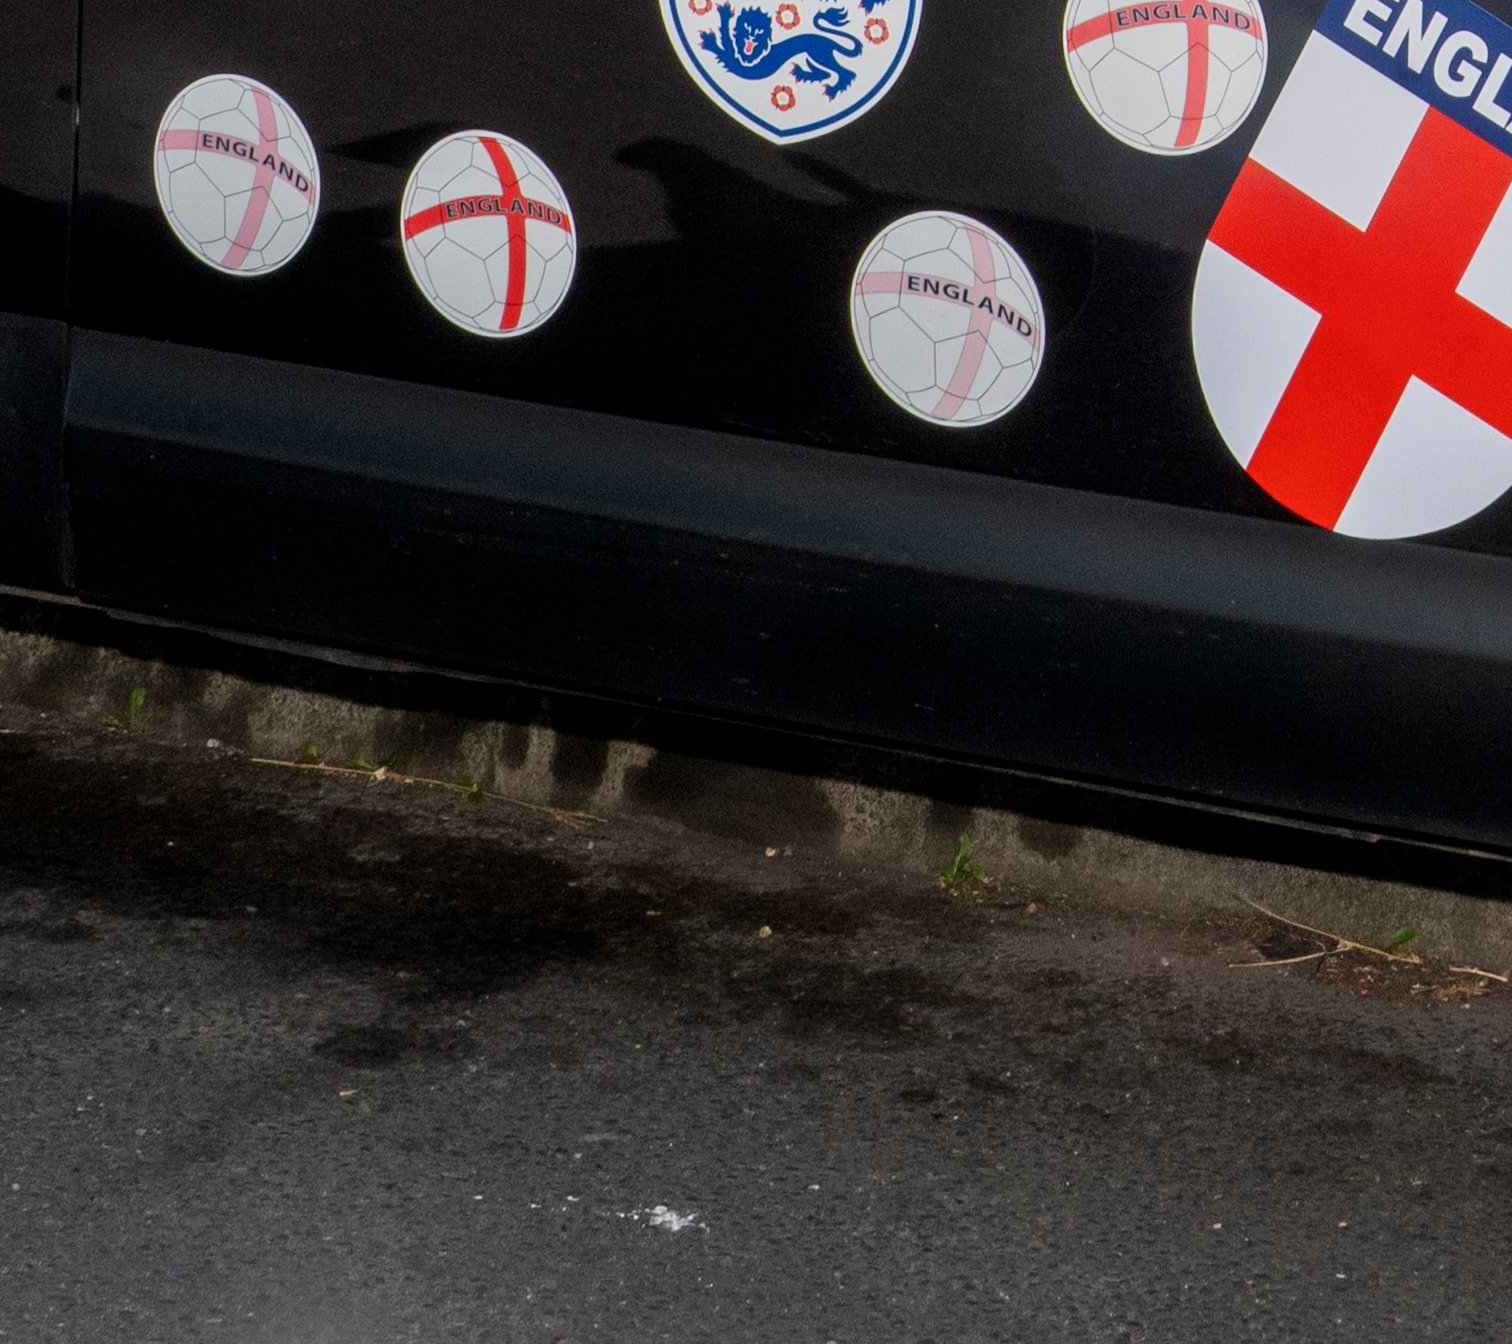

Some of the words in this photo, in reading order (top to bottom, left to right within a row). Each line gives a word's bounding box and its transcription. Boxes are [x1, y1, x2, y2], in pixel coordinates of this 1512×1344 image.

[1115, 2, 1252, 31] ENGLAND
[202, 134, 310, 194] ENGLAND
[446, 199, 562, 225] ENGLAND
[907, 275, 1033, 339] ENGLAND
